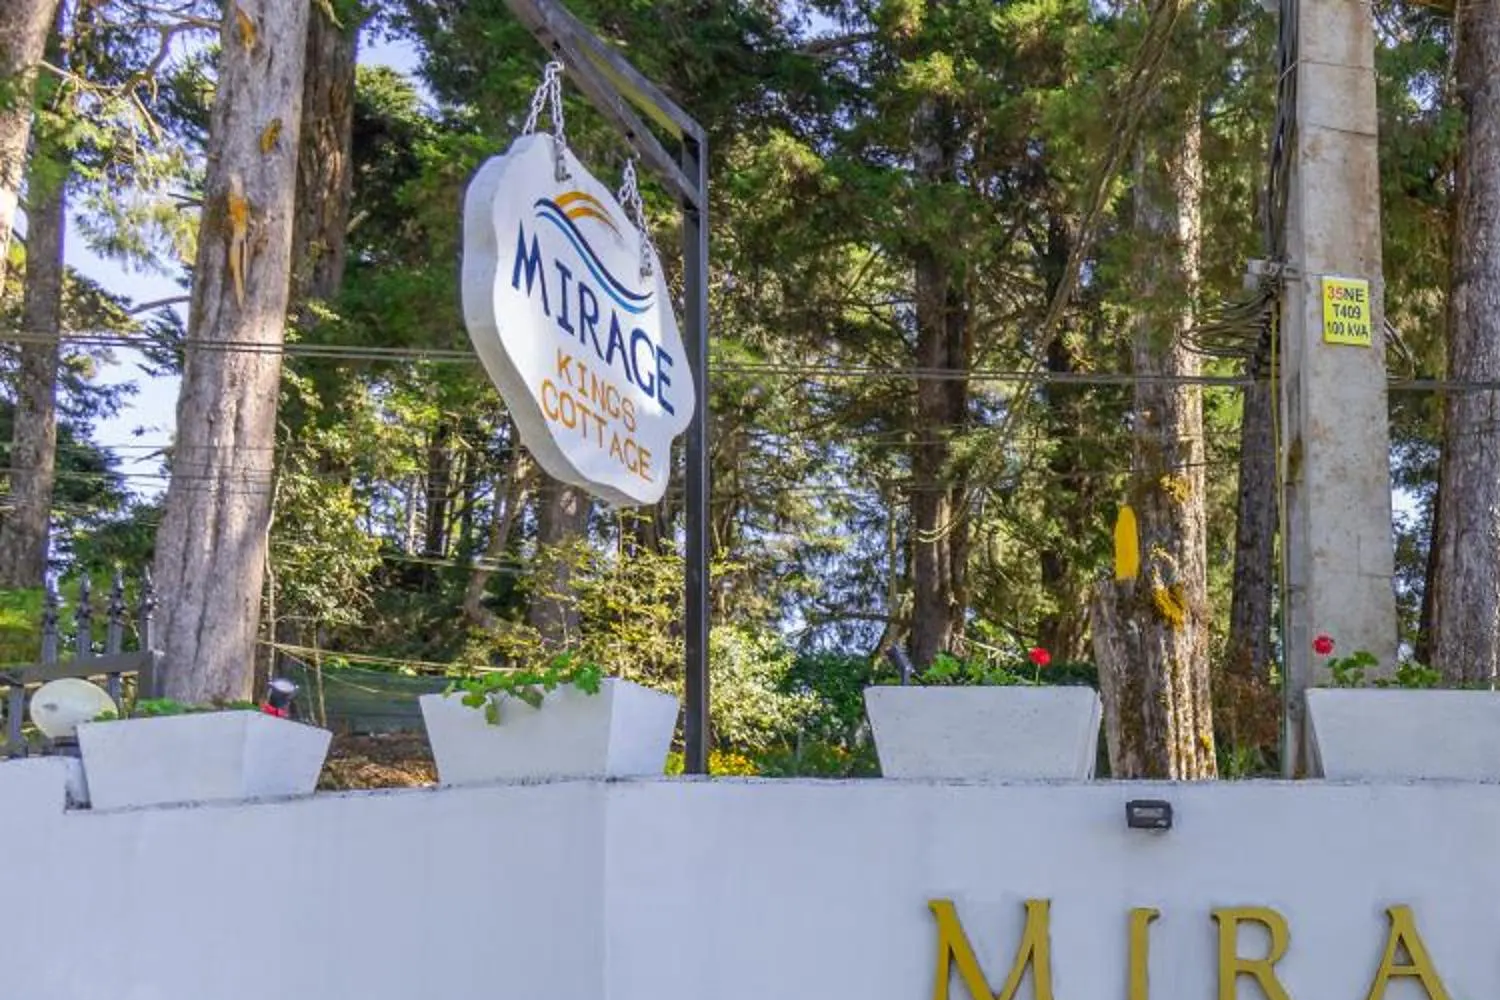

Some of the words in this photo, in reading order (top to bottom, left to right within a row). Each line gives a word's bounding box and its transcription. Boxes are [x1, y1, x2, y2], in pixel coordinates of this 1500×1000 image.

[512, 219, 675, 416] MIRAGE
[1327, 321, 1345, 335] 100
[1332, 303, 1362, 319] T409
[540, 379, 654, 483] COTTAGE
[556, 347, 636, 434] KINGS
